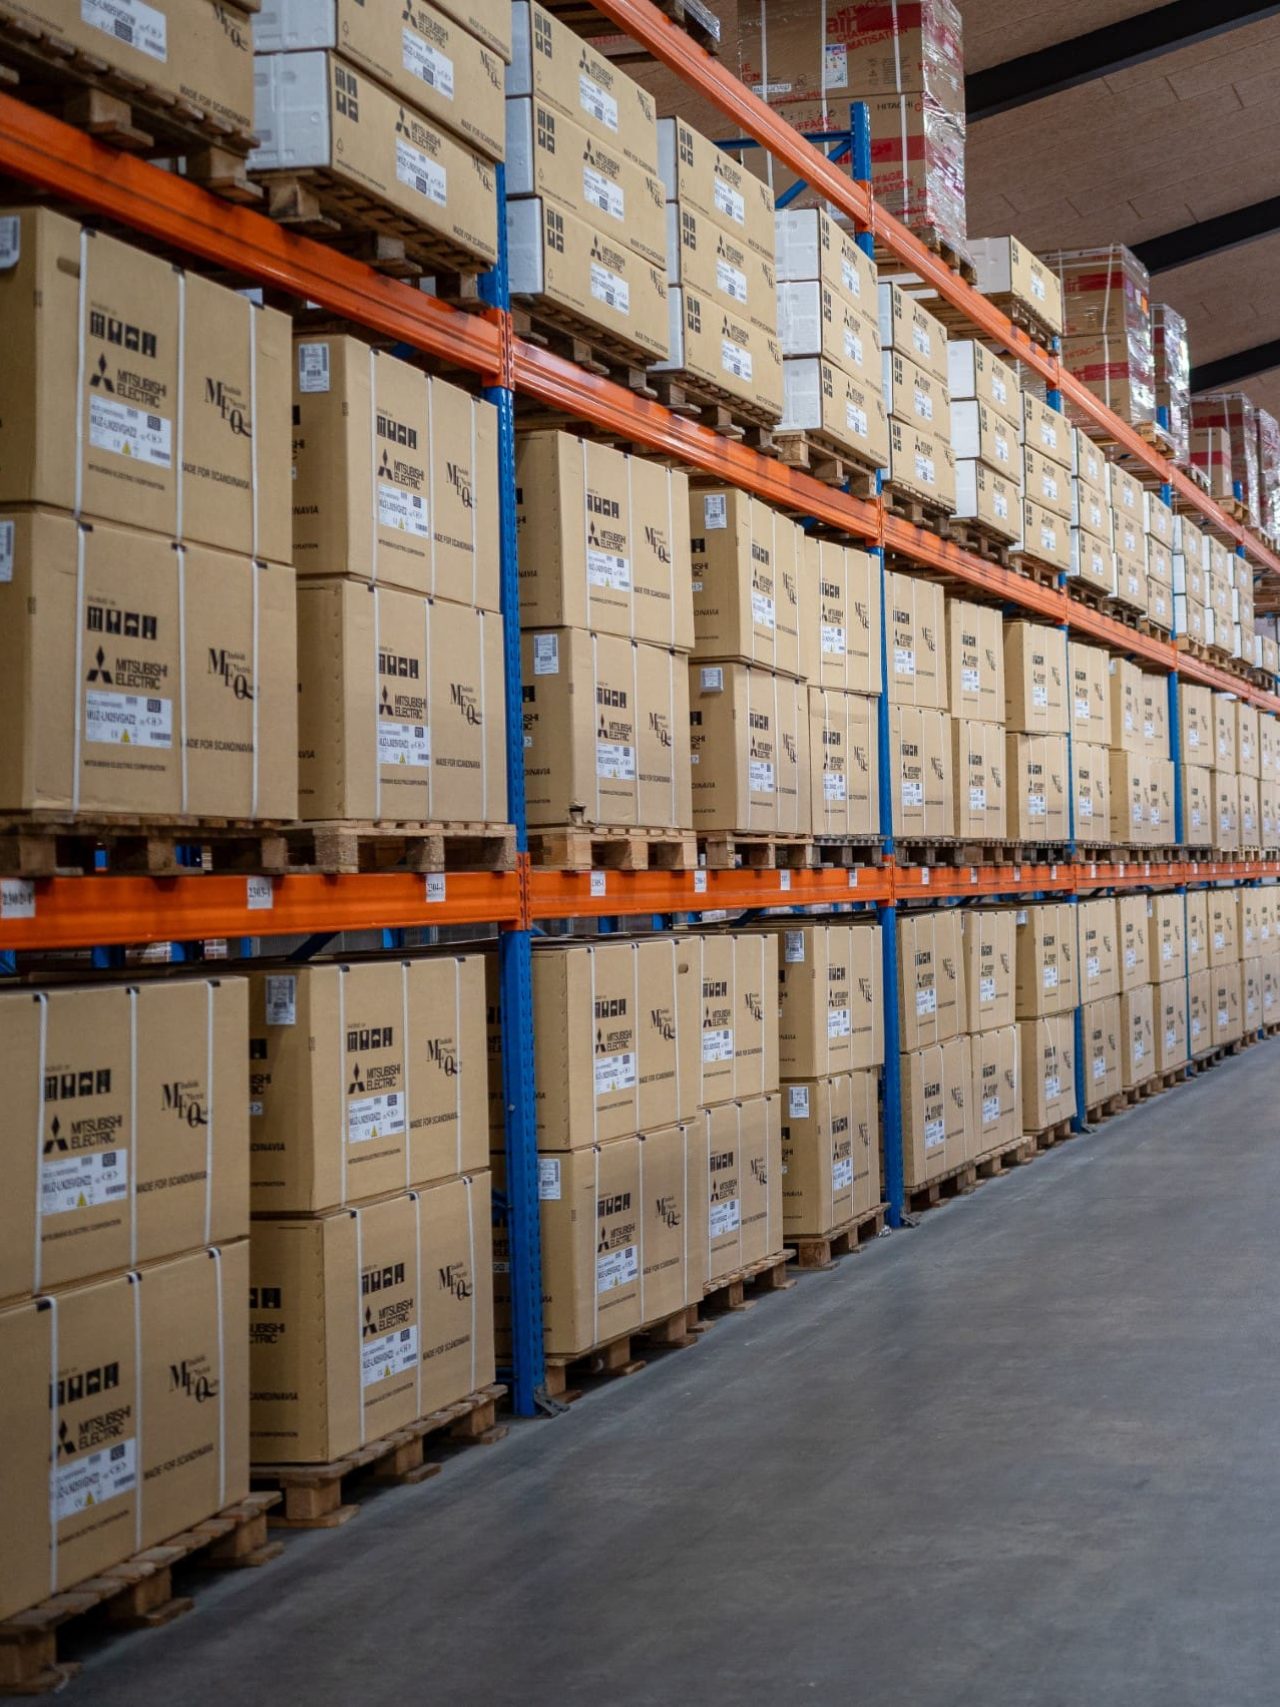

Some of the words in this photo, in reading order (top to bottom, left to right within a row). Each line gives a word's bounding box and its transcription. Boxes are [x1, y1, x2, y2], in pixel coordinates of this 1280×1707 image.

[418, 10, 449, 41] MITSUBISHI
[419, 22, 445, 48] ELECTRIC
[411, 120, 441, 147] MITSUBISHI
[412, 132, 438, 157] ELECTRIC
[117, 369, 168, 397] MITSUBISHI
[117, 383, 161, 409] ELECTRIC
[394, 460, 425, 482] MITSUBISHI
[394, 472, 422, 491] ELECTRIC
[600, 530, 626, 543] MITSUBISHI
[600, 539, 623, 553] ELECTRIC
[116, 658, 168, 678] MITSUBISHI
[116, 671, 161, 690] ELECTRIC
[394, 694, 427, 709] MITSUBISHI
[394, 705, 423, 720] ELECTRIC
[609, 722, 632, 733] MITSUBISHI
[609, 731, 630, 742] ELECTRIC
[606, 1029, 632, 1043] MITSUBISHI
[606, 1039, 629, 1052] ELECTRIC
[366, 1064, 401, 1079] MITSUBISHI
[366, 1076, 396, 1091] ELECTRIC
[71, 1115, 122, 1135] MITSUBISHI
[71, 1130, 116, 1150] ELECTRIC
[610, 1223, 635, 1239] MITSUBISHI
[610, 1235, 632, 1248] ELECTRIC
[379, 1298, 413, 1319] MITSUBISHI
[250, 1322, 285, 1334] UBISHI
[379, 1313, 409, 1333] ELECTRIC
[78, 1405, 131, 1434] MITSUBISHI
[78, 1423, 122, 1450] ELECTRIC
